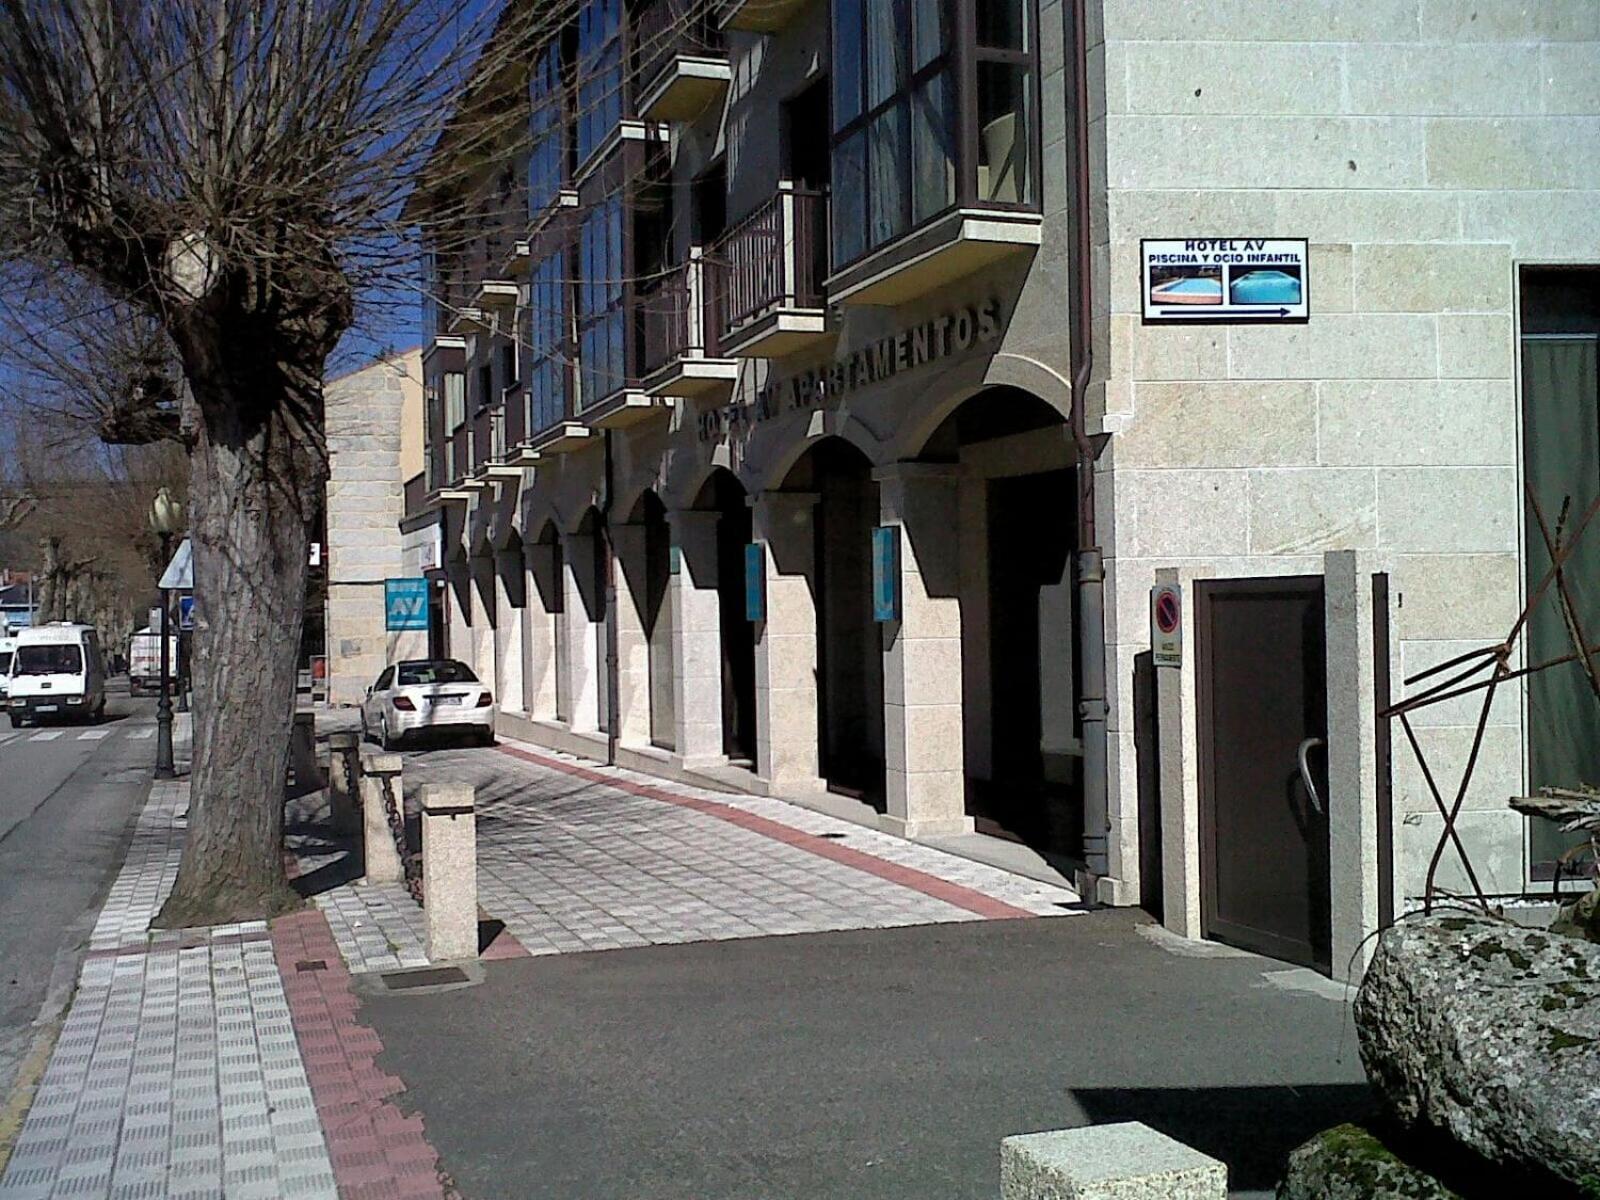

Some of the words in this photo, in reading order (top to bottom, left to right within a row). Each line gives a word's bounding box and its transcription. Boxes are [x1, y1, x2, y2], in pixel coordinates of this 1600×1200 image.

[1185, 240, 1238, 251] HOTEL
[1243, 240, 1266, 251] AV
[1149, 254, 1198, 263] PISCINA
[1202, 254, 1210, 262] Y
[1213, 253, 1244, 263] OCIO
[1247, 253, 1301, 263] INFANTIL
[788, 298, 1000, 409] APARTAMENTOS
[388, 597, 424, 616] AV
